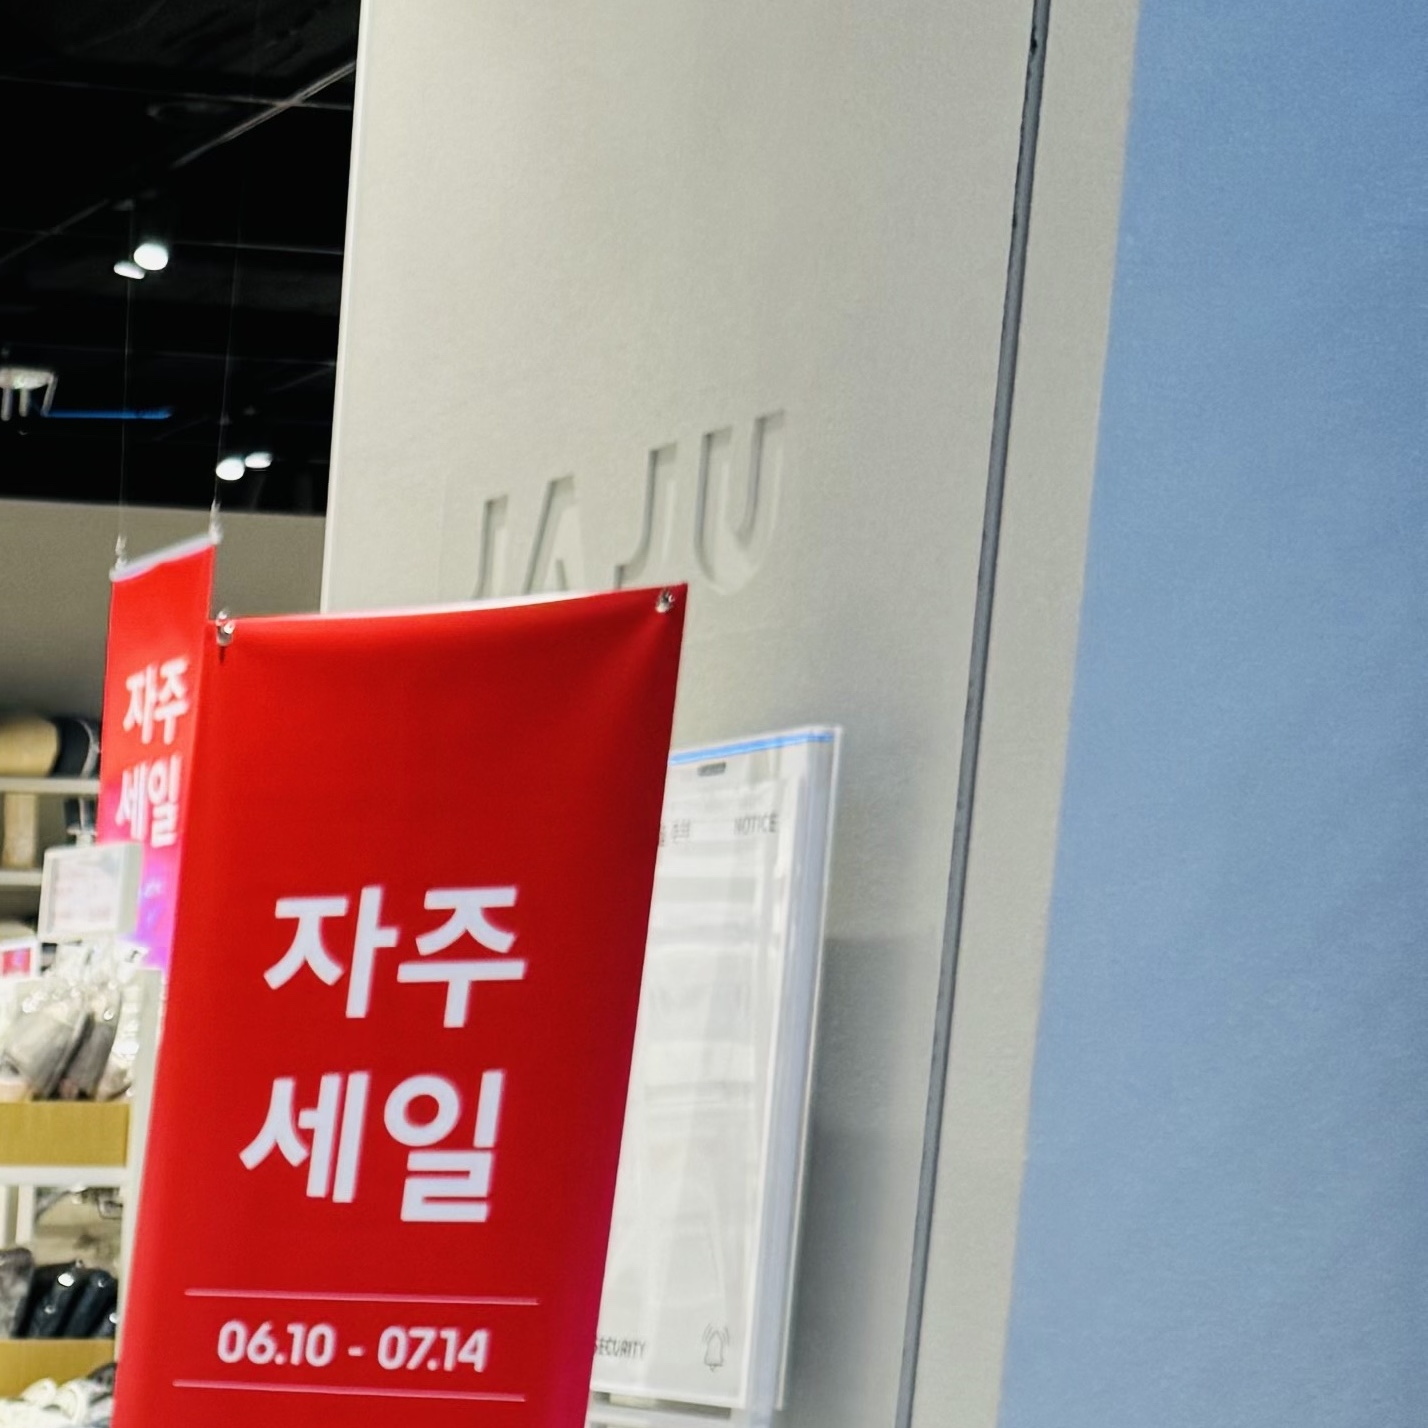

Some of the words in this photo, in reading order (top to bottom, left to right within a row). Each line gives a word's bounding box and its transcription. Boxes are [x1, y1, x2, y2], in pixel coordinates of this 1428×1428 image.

[123, 656, 189, 744] 자주
[115, 754, 182, 848] 세일
[264, 885, 526, 1028] 자주
[239, 1070, 506, 1223] 세일
[217, 1319, 336, 1367] 06.10
[377, 1325, 489, 1373] 07.14
[596, 1336, 646, 1359] ECURITY
